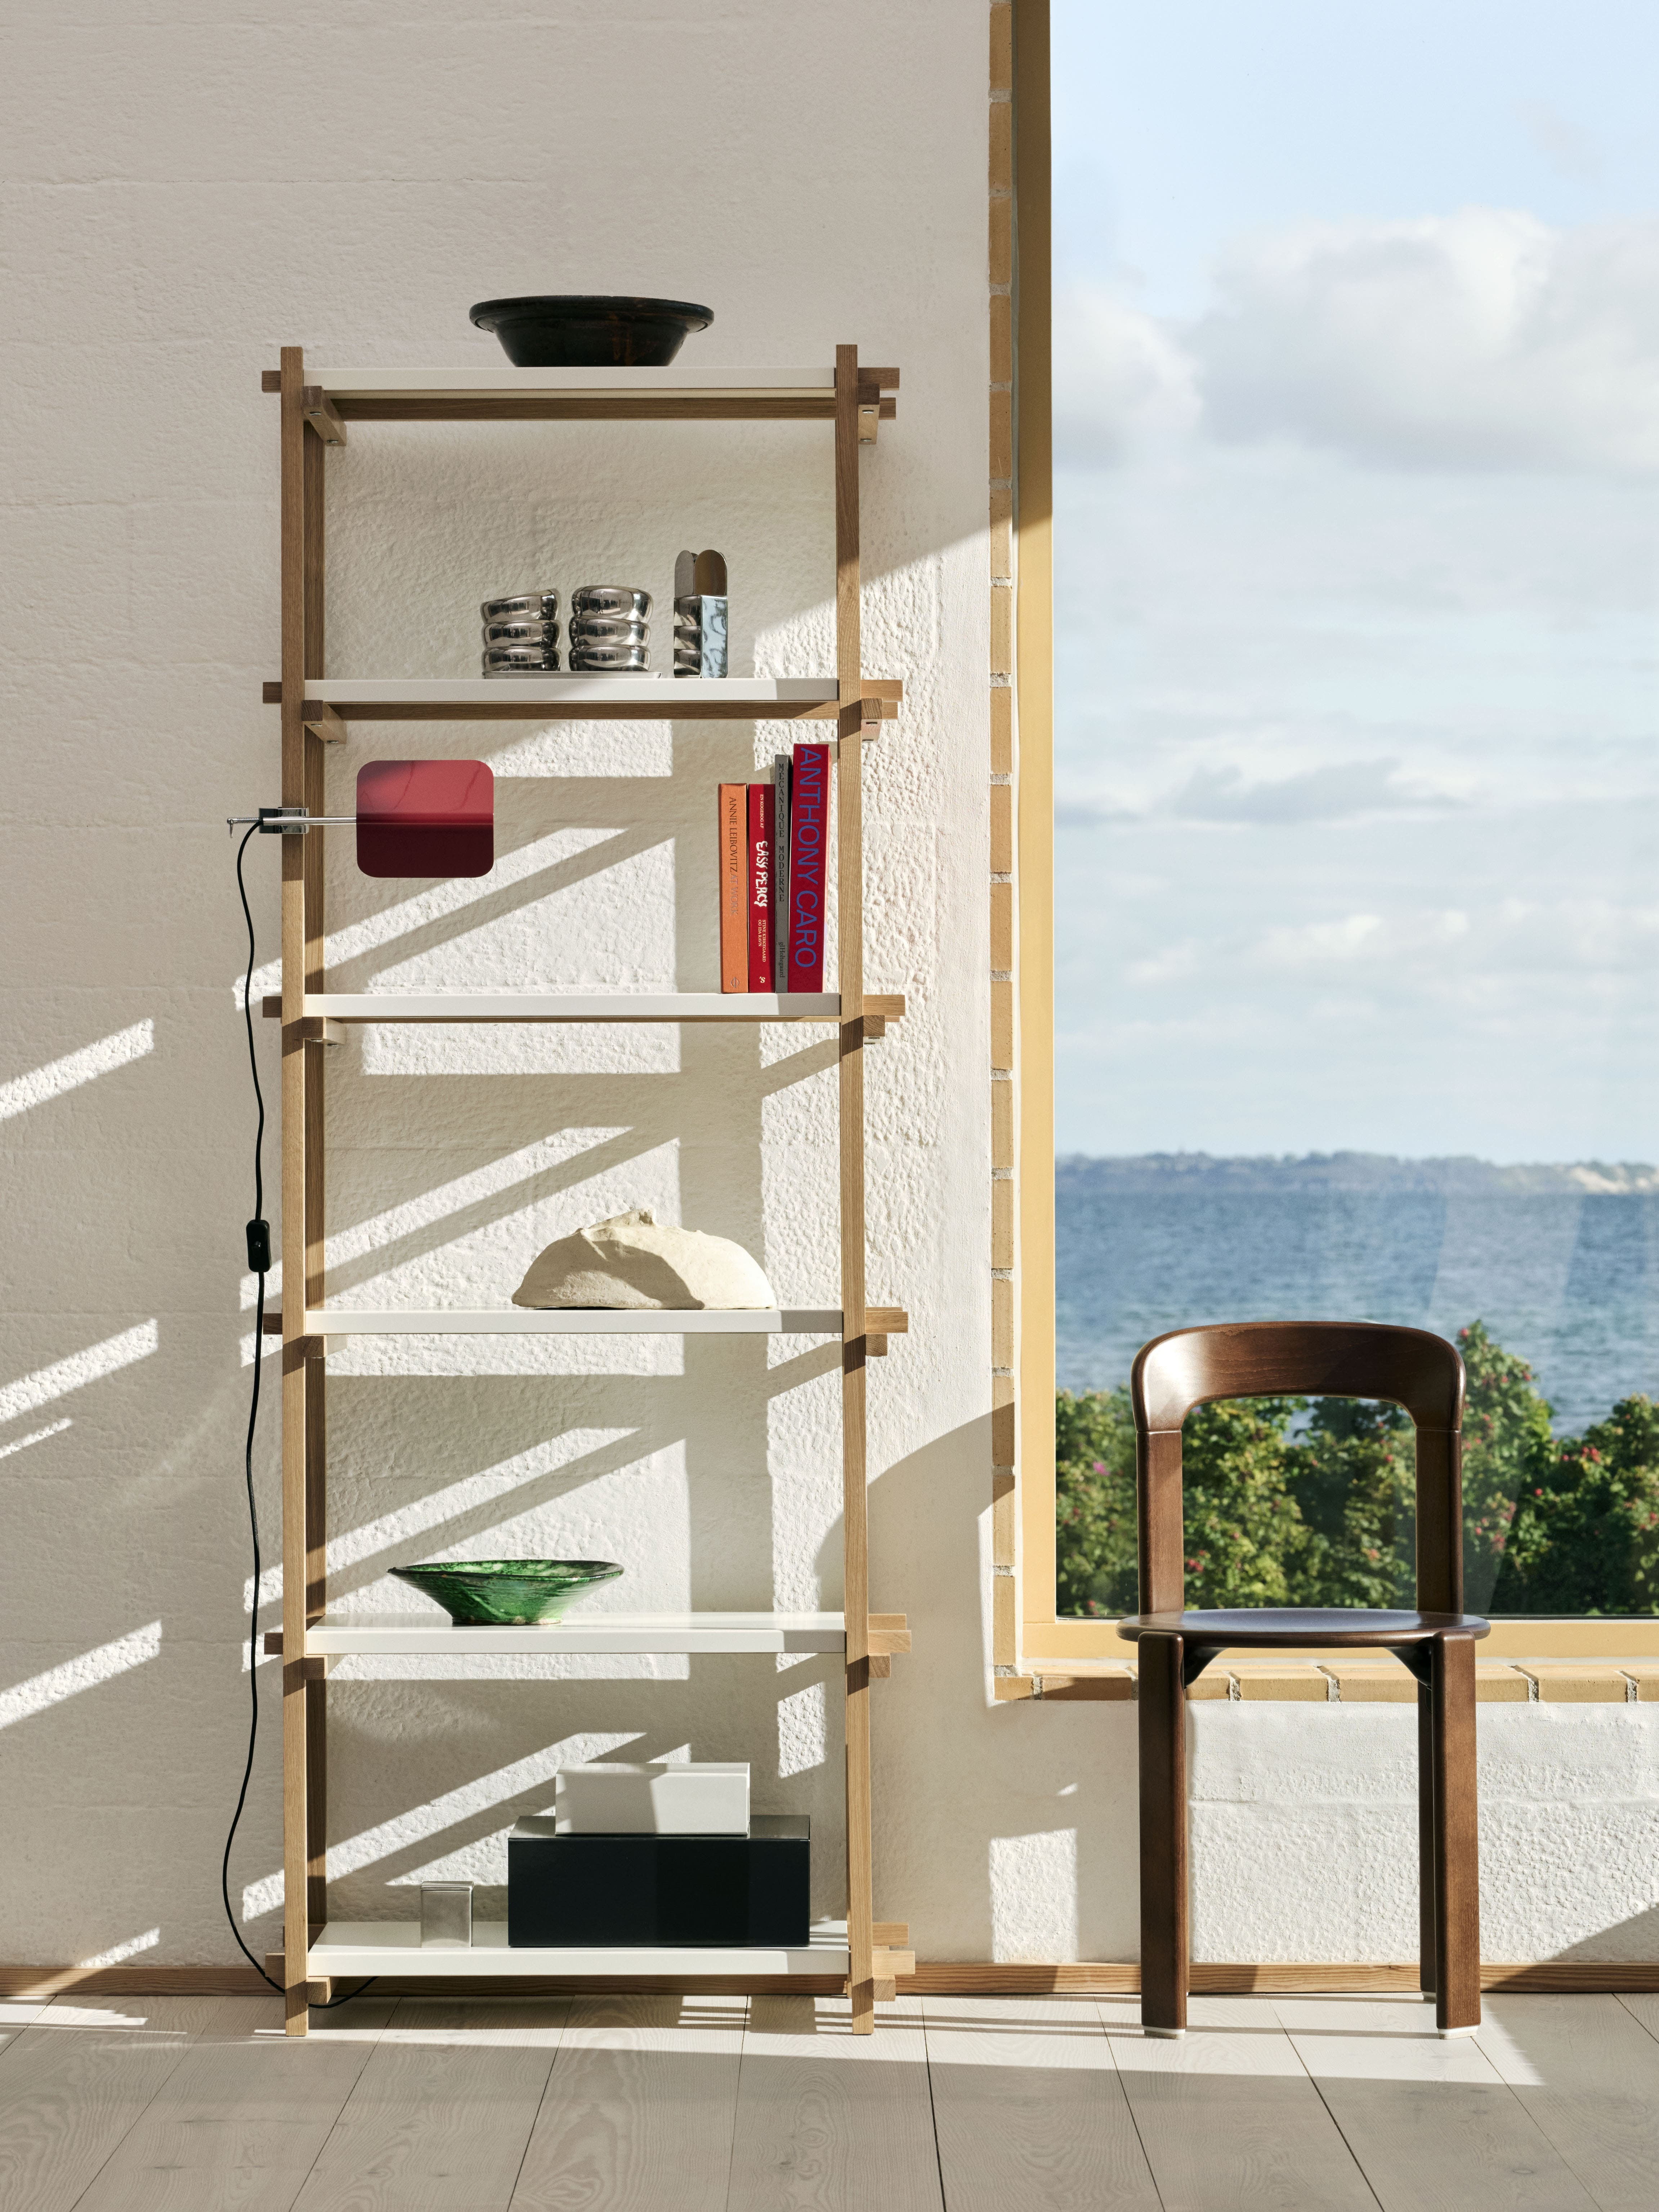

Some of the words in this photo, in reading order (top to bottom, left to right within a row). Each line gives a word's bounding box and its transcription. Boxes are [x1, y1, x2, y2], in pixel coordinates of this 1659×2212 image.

[729, 797, 737, 825] ANNIE
[797, 747, 821, 885] ANTHONY
[729, 828, 738, 873] LEIBOVITZ
[756, 840, 769, 870] EASY
[730, 873, 738, 885] AT
[754, 871, 768, 907] PEACY
[795, 890, 818, 967] CARO
